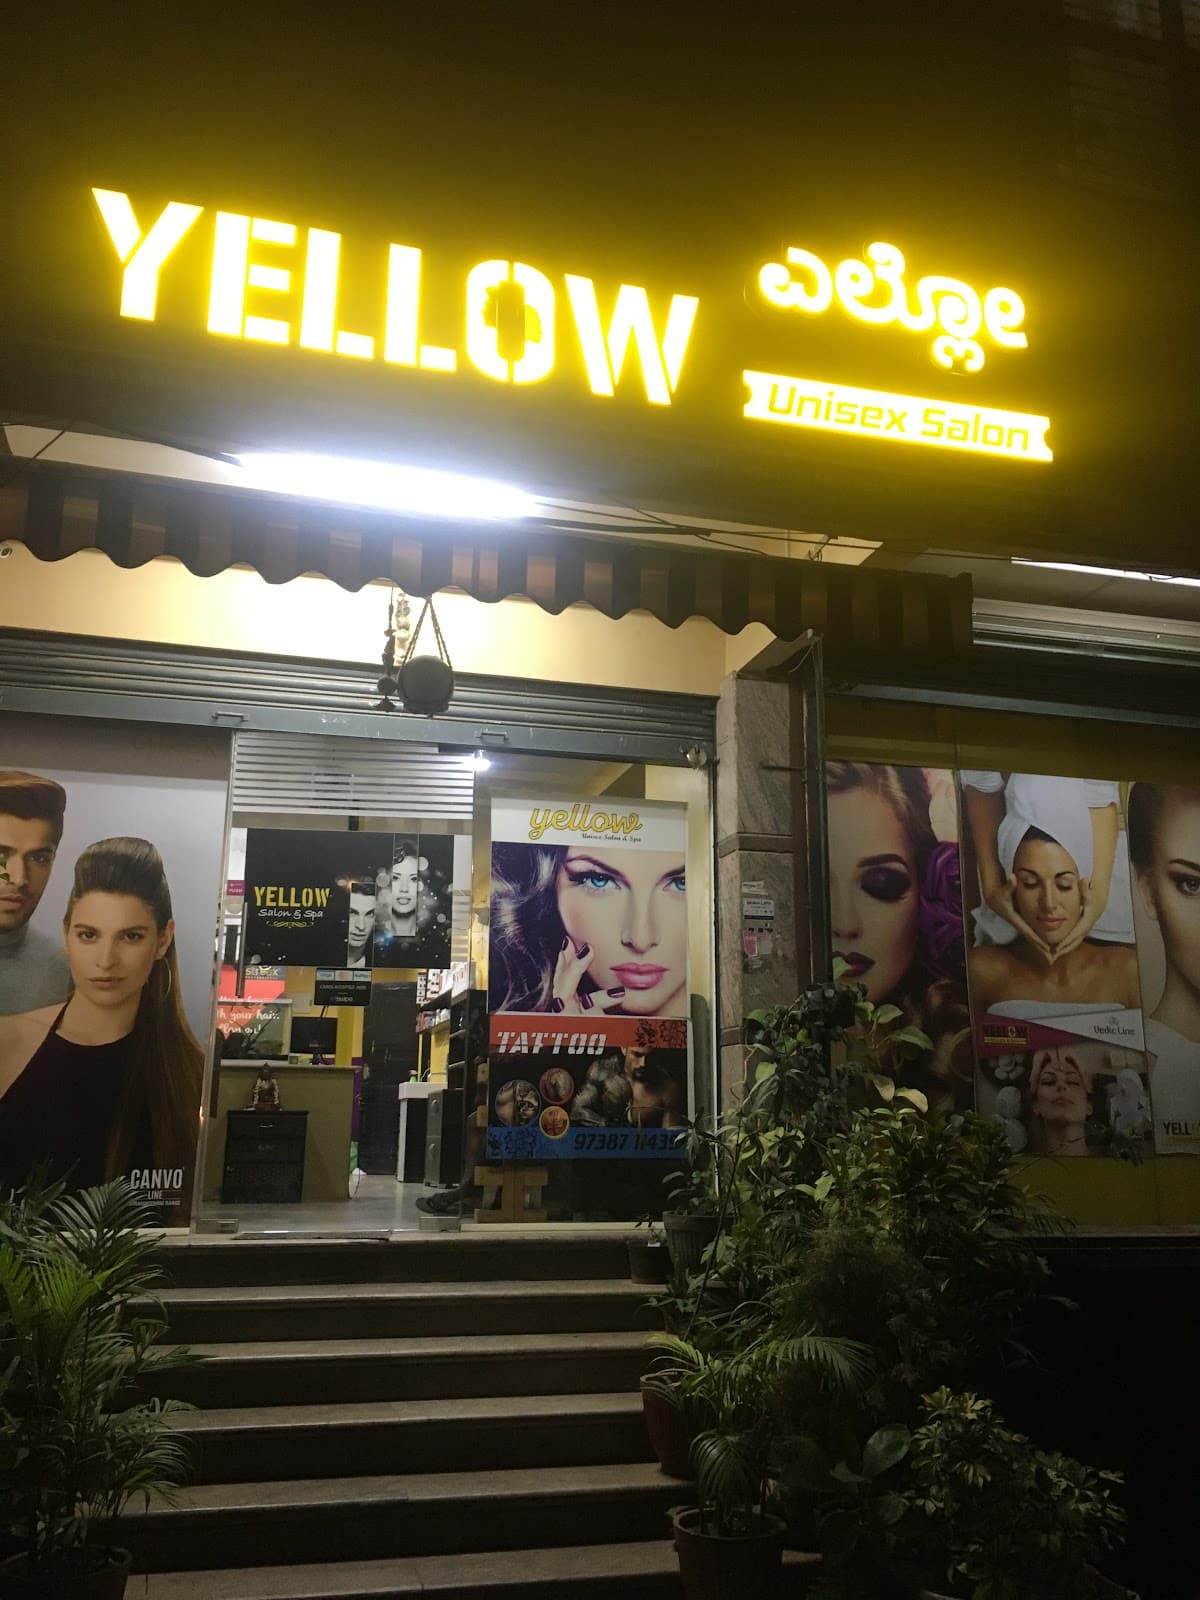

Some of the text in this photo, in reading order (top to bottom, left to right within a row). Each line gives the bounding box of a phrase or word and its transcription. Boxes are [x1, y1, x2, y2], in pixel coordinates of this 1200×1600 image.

[91, 186, 700, 406] YELLOW
[768, 383, 1031, 452] Unisex Salon
[528, 803, 643, 840] yellow
[253, 886, 331, 908] YELLOW
[257, 908, 324, 921] Salon & Spa
[497, 1031, 607, 1056] TATTOO
[574, 1133, 628, 1150] 97387
[130, 1168, 183, 1190] CANVO
